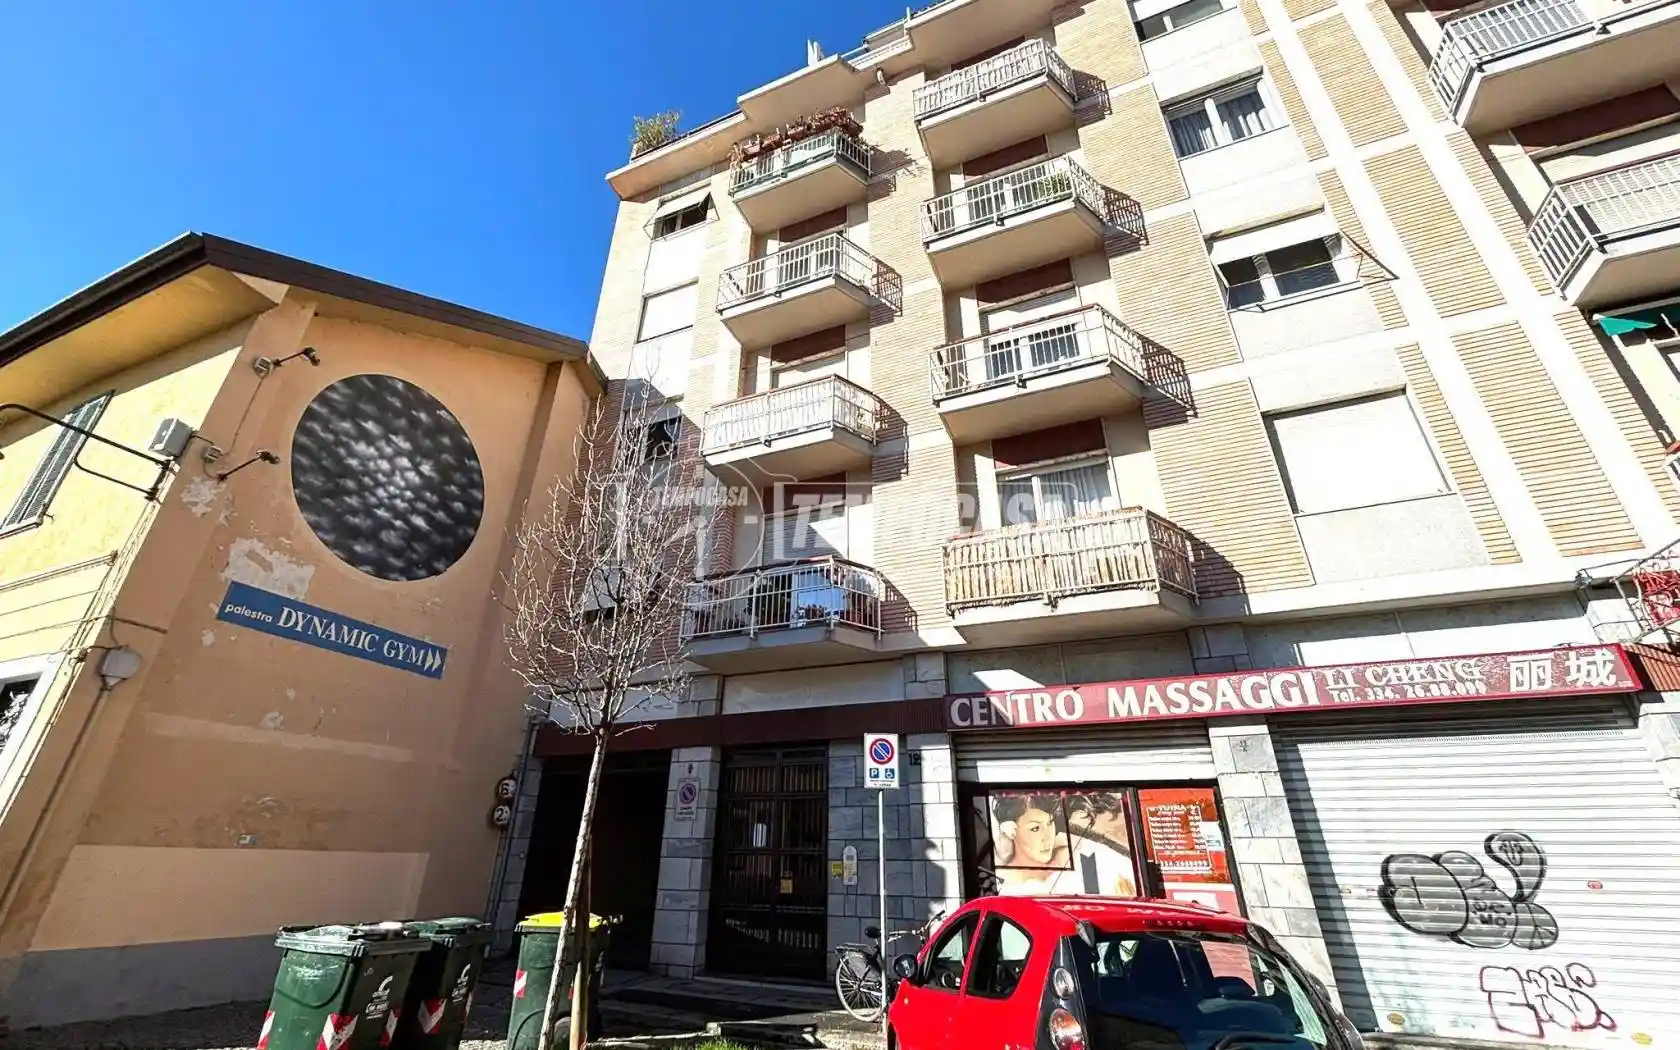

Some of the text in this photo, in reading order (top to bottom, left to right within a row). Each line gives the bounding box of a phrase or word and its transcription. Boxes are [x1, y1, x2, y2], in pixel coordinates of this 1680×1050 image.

[224, 602, 424, 667] palestra DYNAMIC GYM
[1322, 669, 1361, 690] LI
[1506, 648, 1617, 693] 丽城
[950, 672, 1319, 727] CENTRO MASSAGGI
[1328, 690, 1362, 703] Tel.
